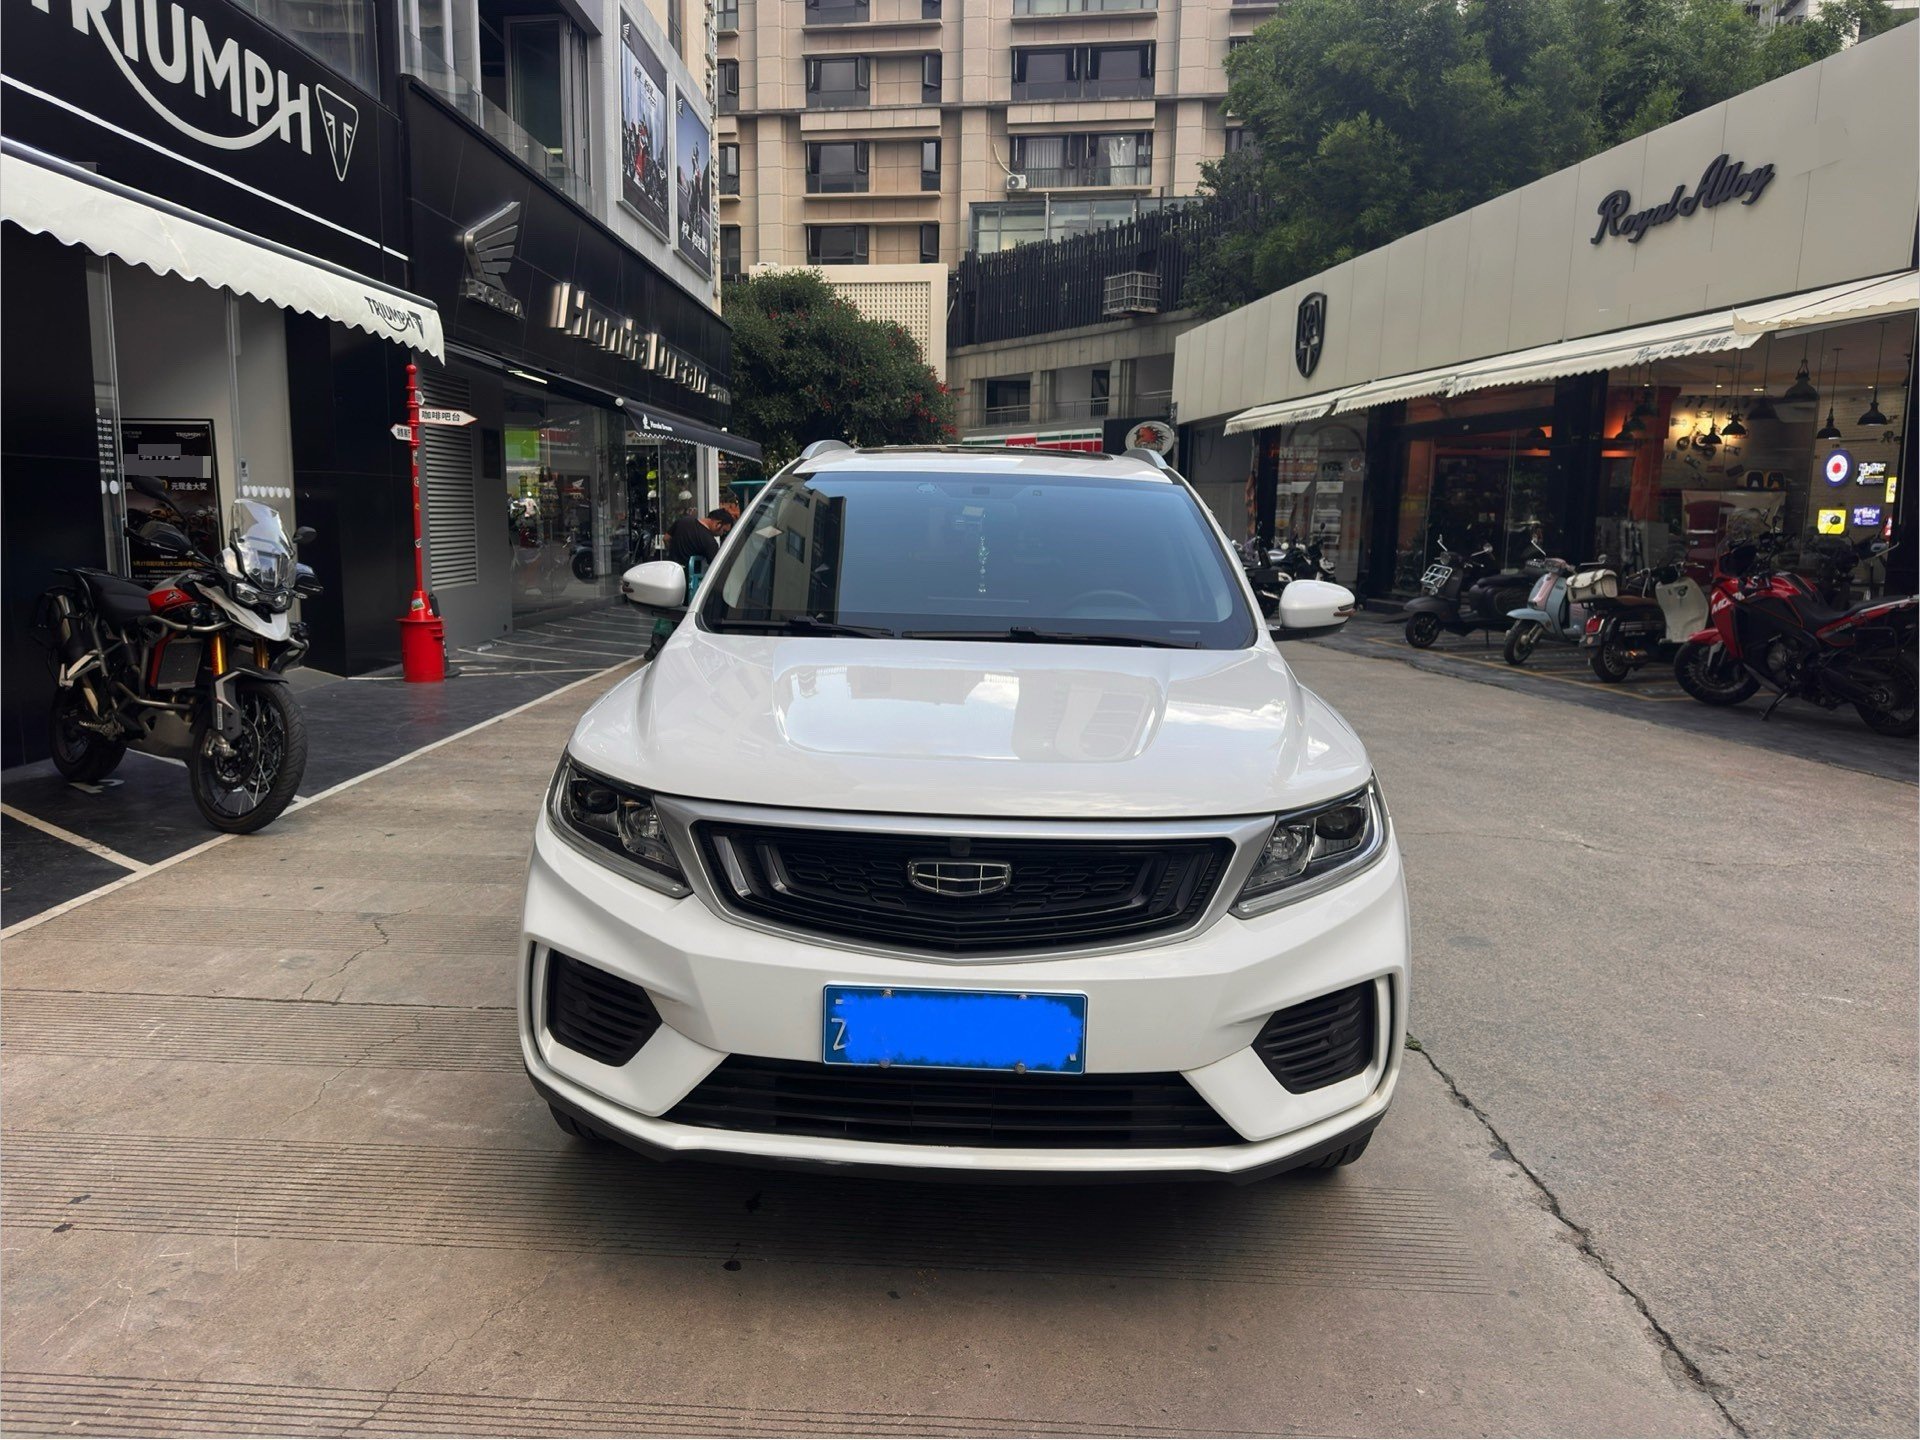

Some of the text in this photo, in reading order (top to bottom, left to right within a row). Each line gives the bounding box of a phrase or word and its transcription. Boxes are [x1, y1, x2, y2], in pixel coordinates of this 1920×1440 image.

[1590, 153, 1775, 245] Royal Alloy
[364, 296, 415, 332] TRIUMPH
[421, 410, 460, 422] 咖啡吧台
